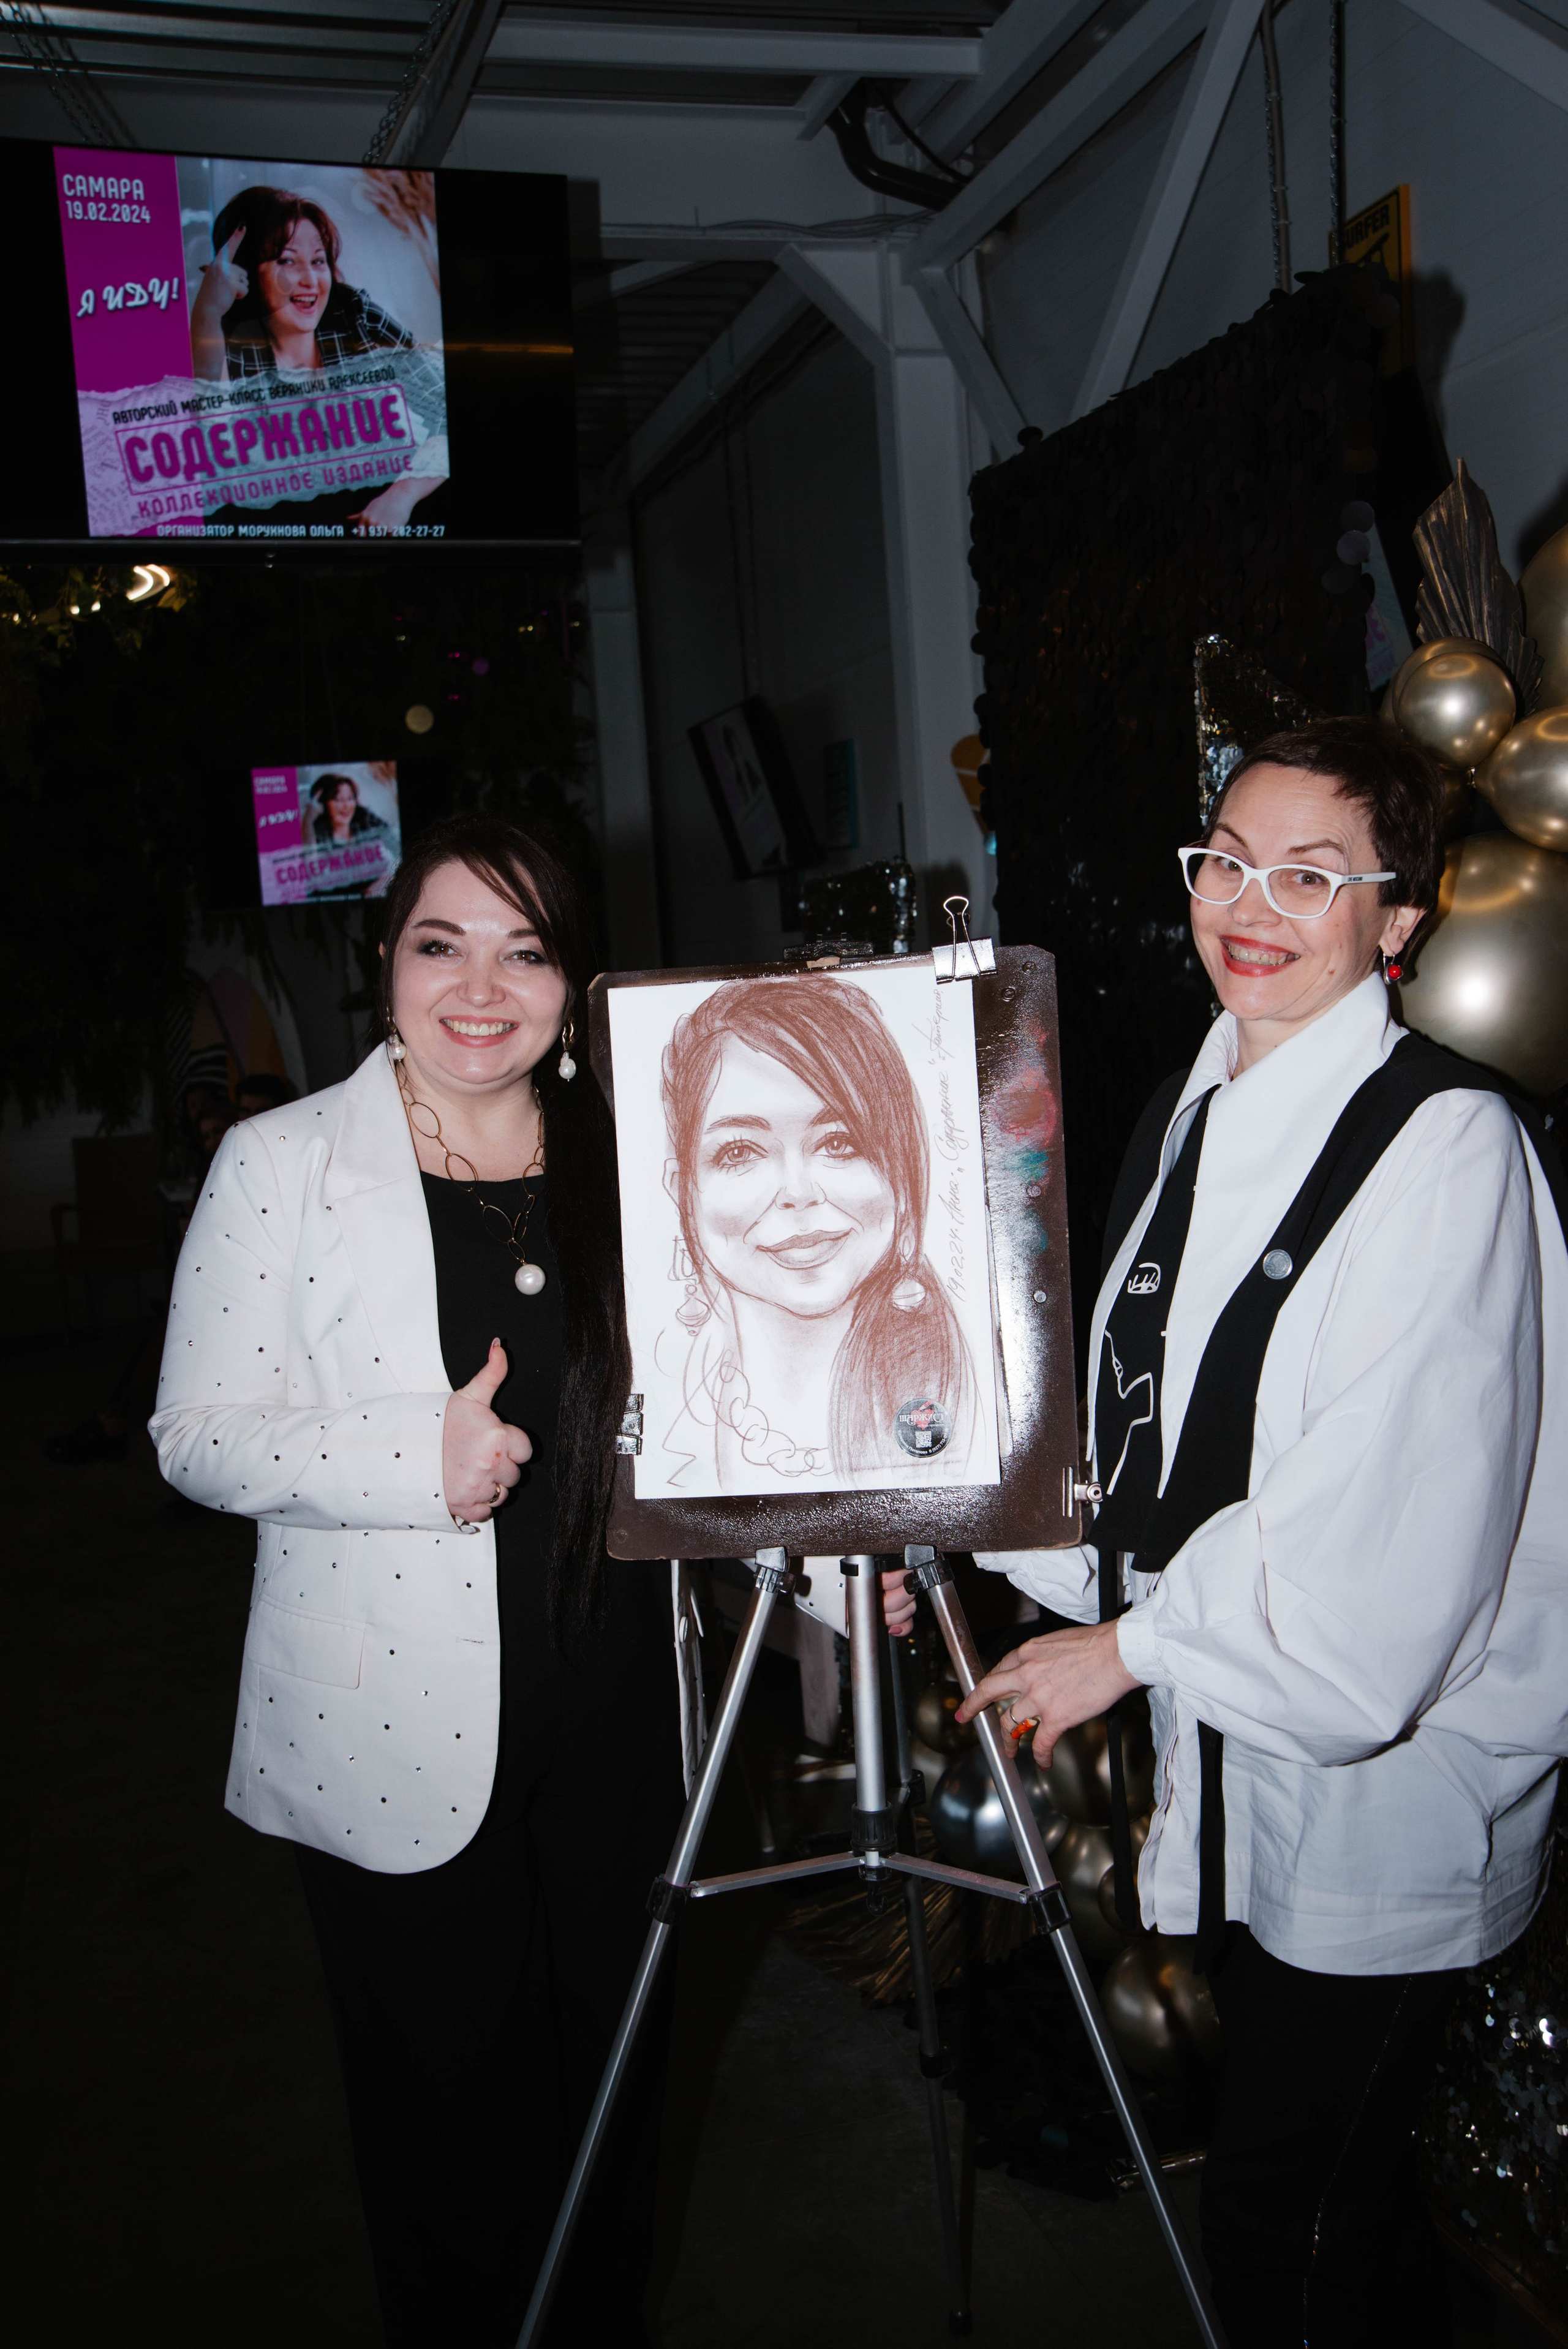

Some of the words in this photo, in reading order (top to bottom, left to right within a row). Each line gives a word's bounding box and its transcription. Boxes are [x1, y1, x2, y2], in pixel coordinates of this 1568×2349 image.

[62, 173, 145, 201] САМАРА
[66, 200, 151, 224] 19.02.2024
[1339, 204, 1390, 250] URFER
[76, 288, 95, 318] Я
[102, 277, 179, 311] ИДУ!
[113, 400, 178, 424] АВТОРСКИЙ
[181, 388, 265, 413] МАСТЕР-КЛАСС
[124, 395, 405, 483] СОДЕРЖАНИЕ
[138, 472, 314, 518] КОЛЛЕКЦИОННОЕ
[322, 454, 413, 486] ИЗДАНИЕ
[157, 524, 235, 537] ОРГАНИЗАТОР
[309, 524, 344, 537] ОЛЬГА
[351, 525, 366, 537] +7
